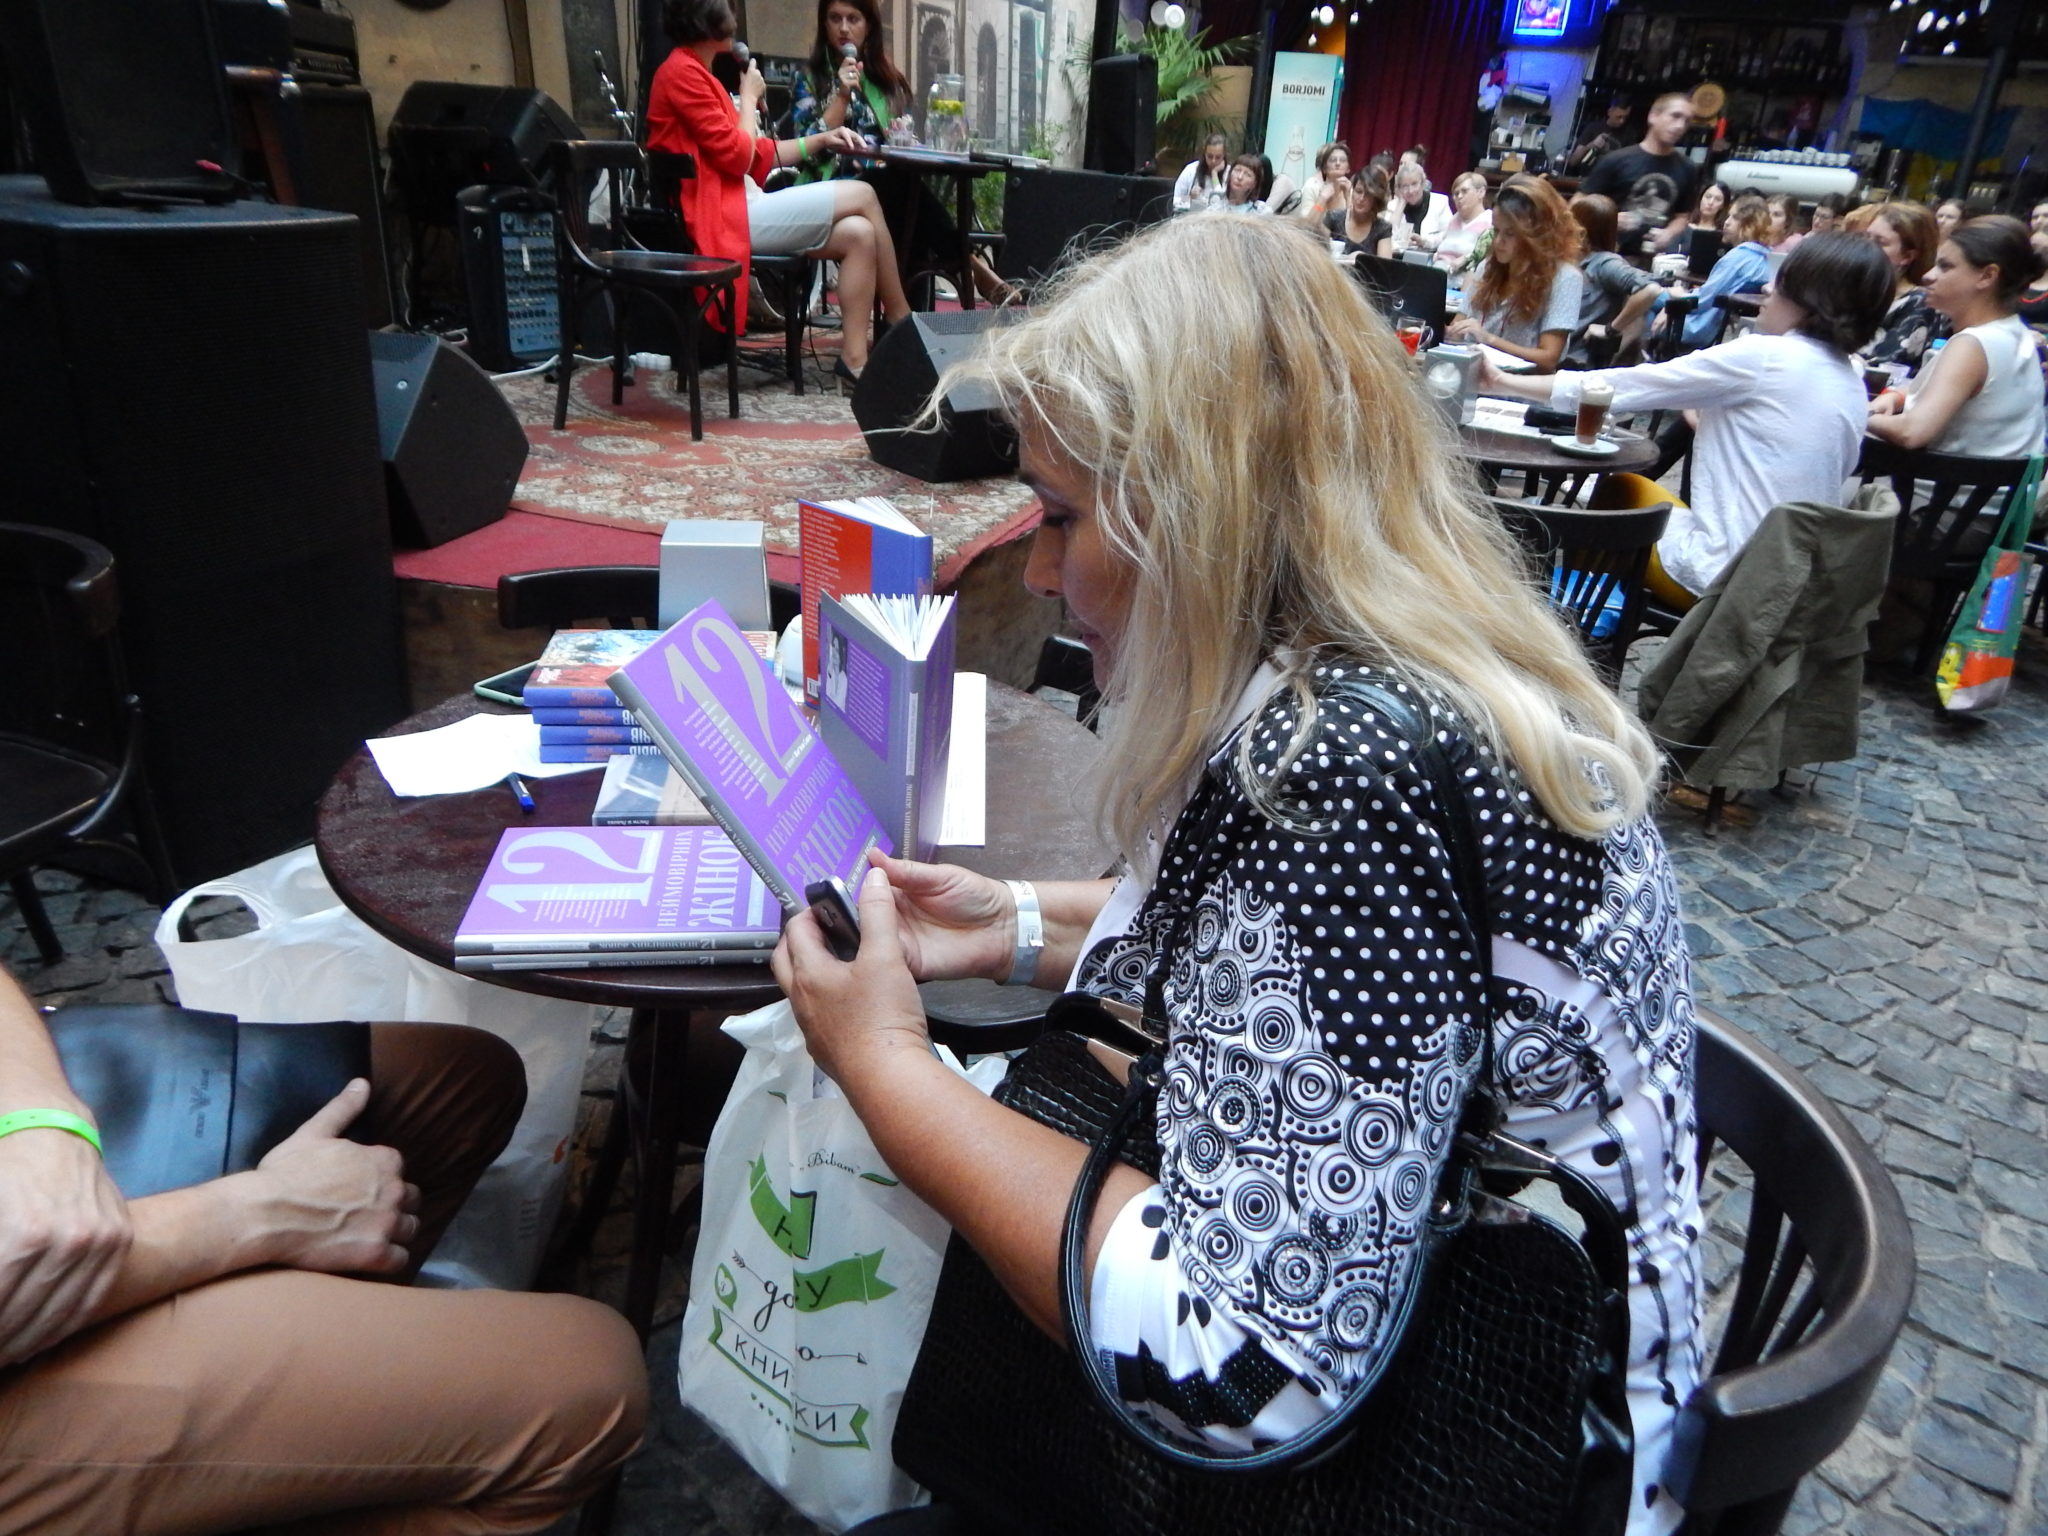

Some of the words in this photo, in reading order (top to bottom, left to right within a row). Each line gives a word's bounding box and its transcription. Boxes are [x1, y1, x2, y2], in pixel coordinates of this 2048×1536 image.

[1282, 84, 1325, 95] BORJOMI
[664, 617, 816, 807] 12
[486, 829, 664, 914] 12
[656, 829, 694, 928] НЕЙМОВІРНИХ
[687, 829, 742, 928] ЖІНОК
[786, 779, 867, 884] ЖІНОК
